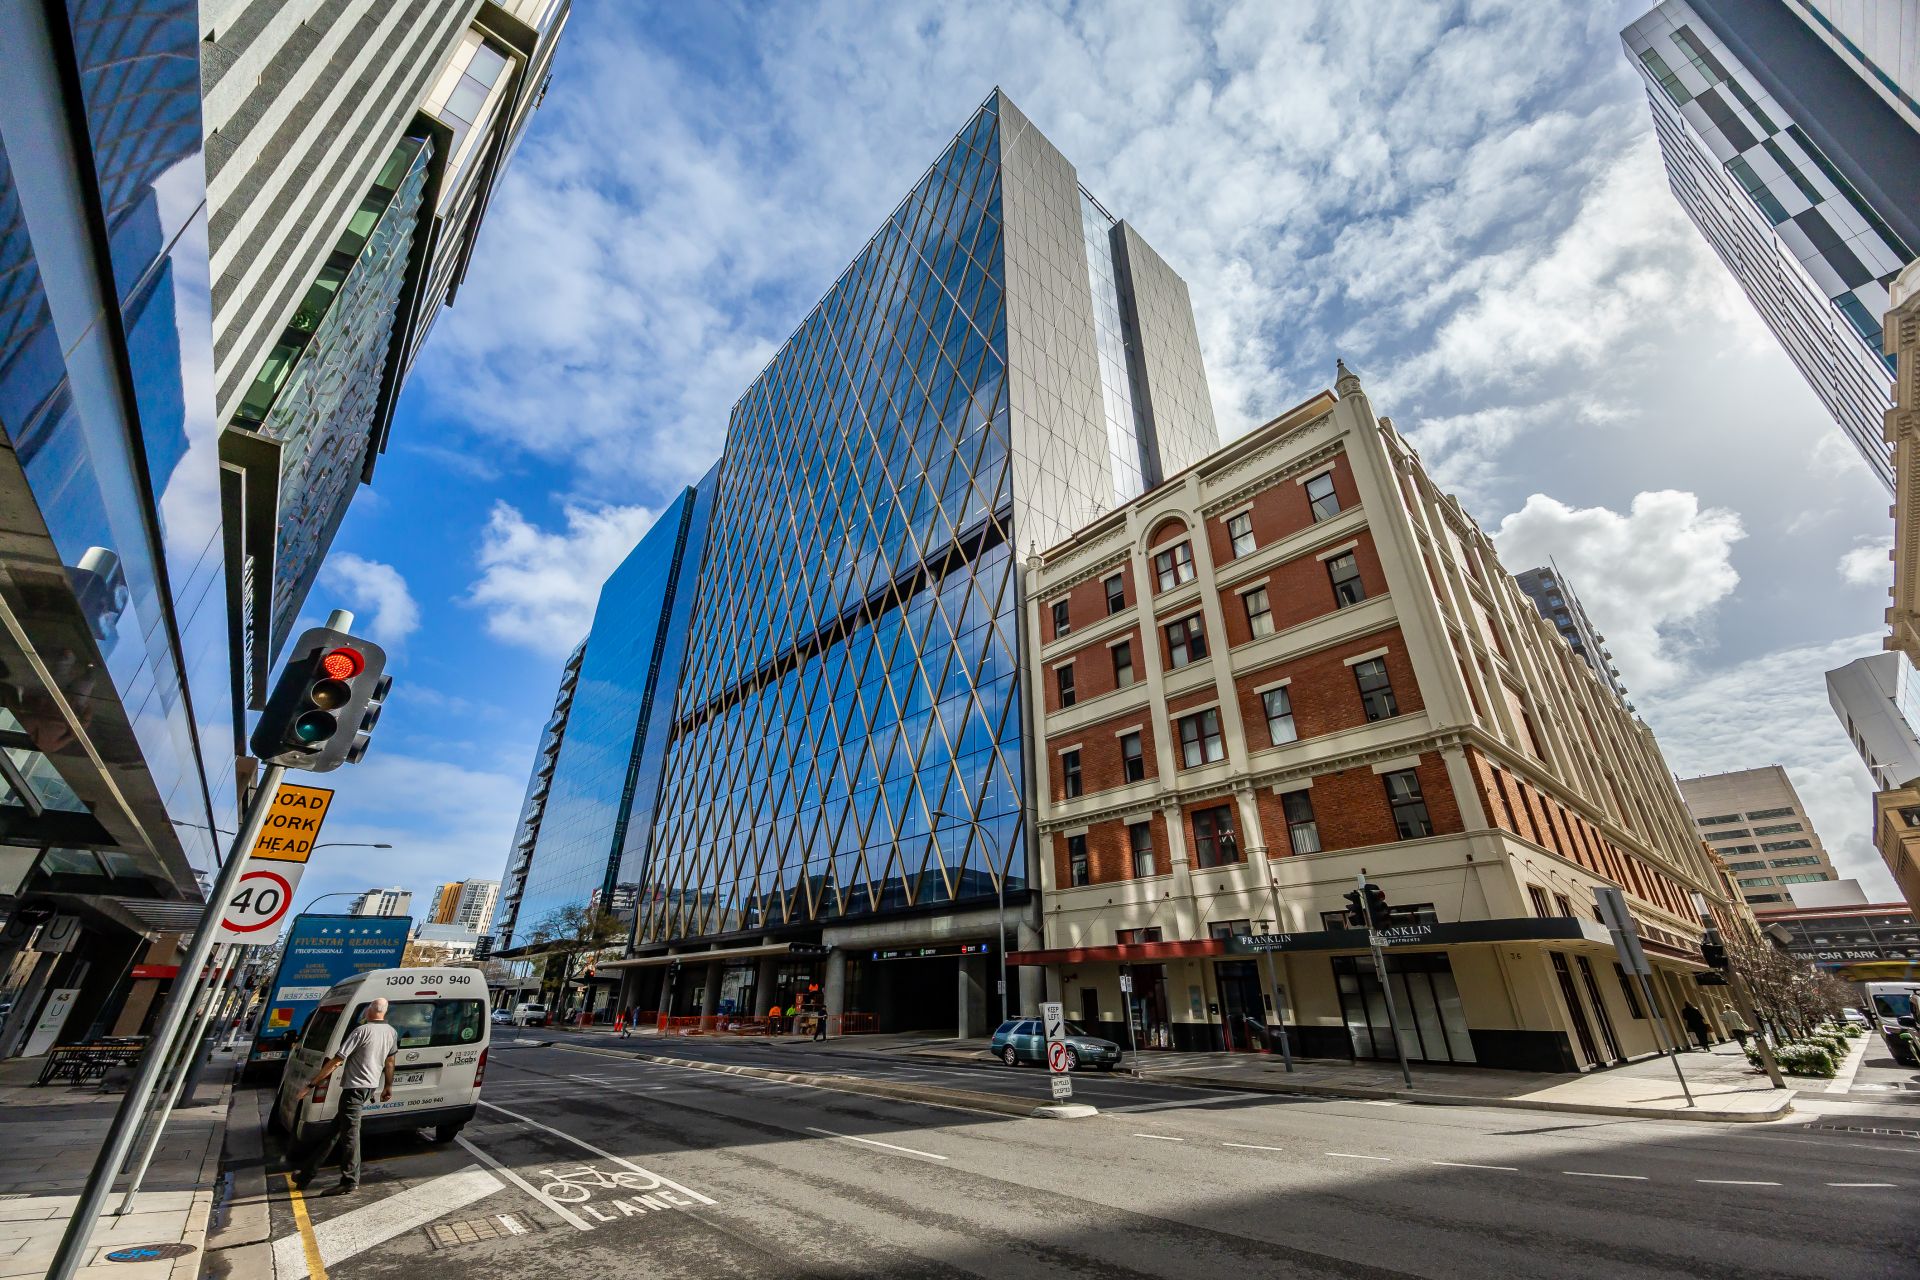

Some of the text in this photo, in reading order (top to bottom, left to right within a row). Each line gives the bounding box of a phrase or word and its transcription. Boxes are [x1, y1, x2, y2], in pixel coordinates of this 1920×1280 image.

[254, 836, 310, 853] HEAD
[229, 887, 280, 916] 40
[294, 937, 400, 946] FIVESTAR REMOVALS
[1242, 934, 1292, 945] FRANKLIN
[1818, 952, 1842, 960] CAR
[1845, 950, 1879, 959] PARK
[386, 975, 471, 986] 1300 360 940
[1048, 1013, 1060, 1021] LEFT
[381, 1101, 405, 1109] ACCESS
[582, 1190, 694, 1222] LANE
